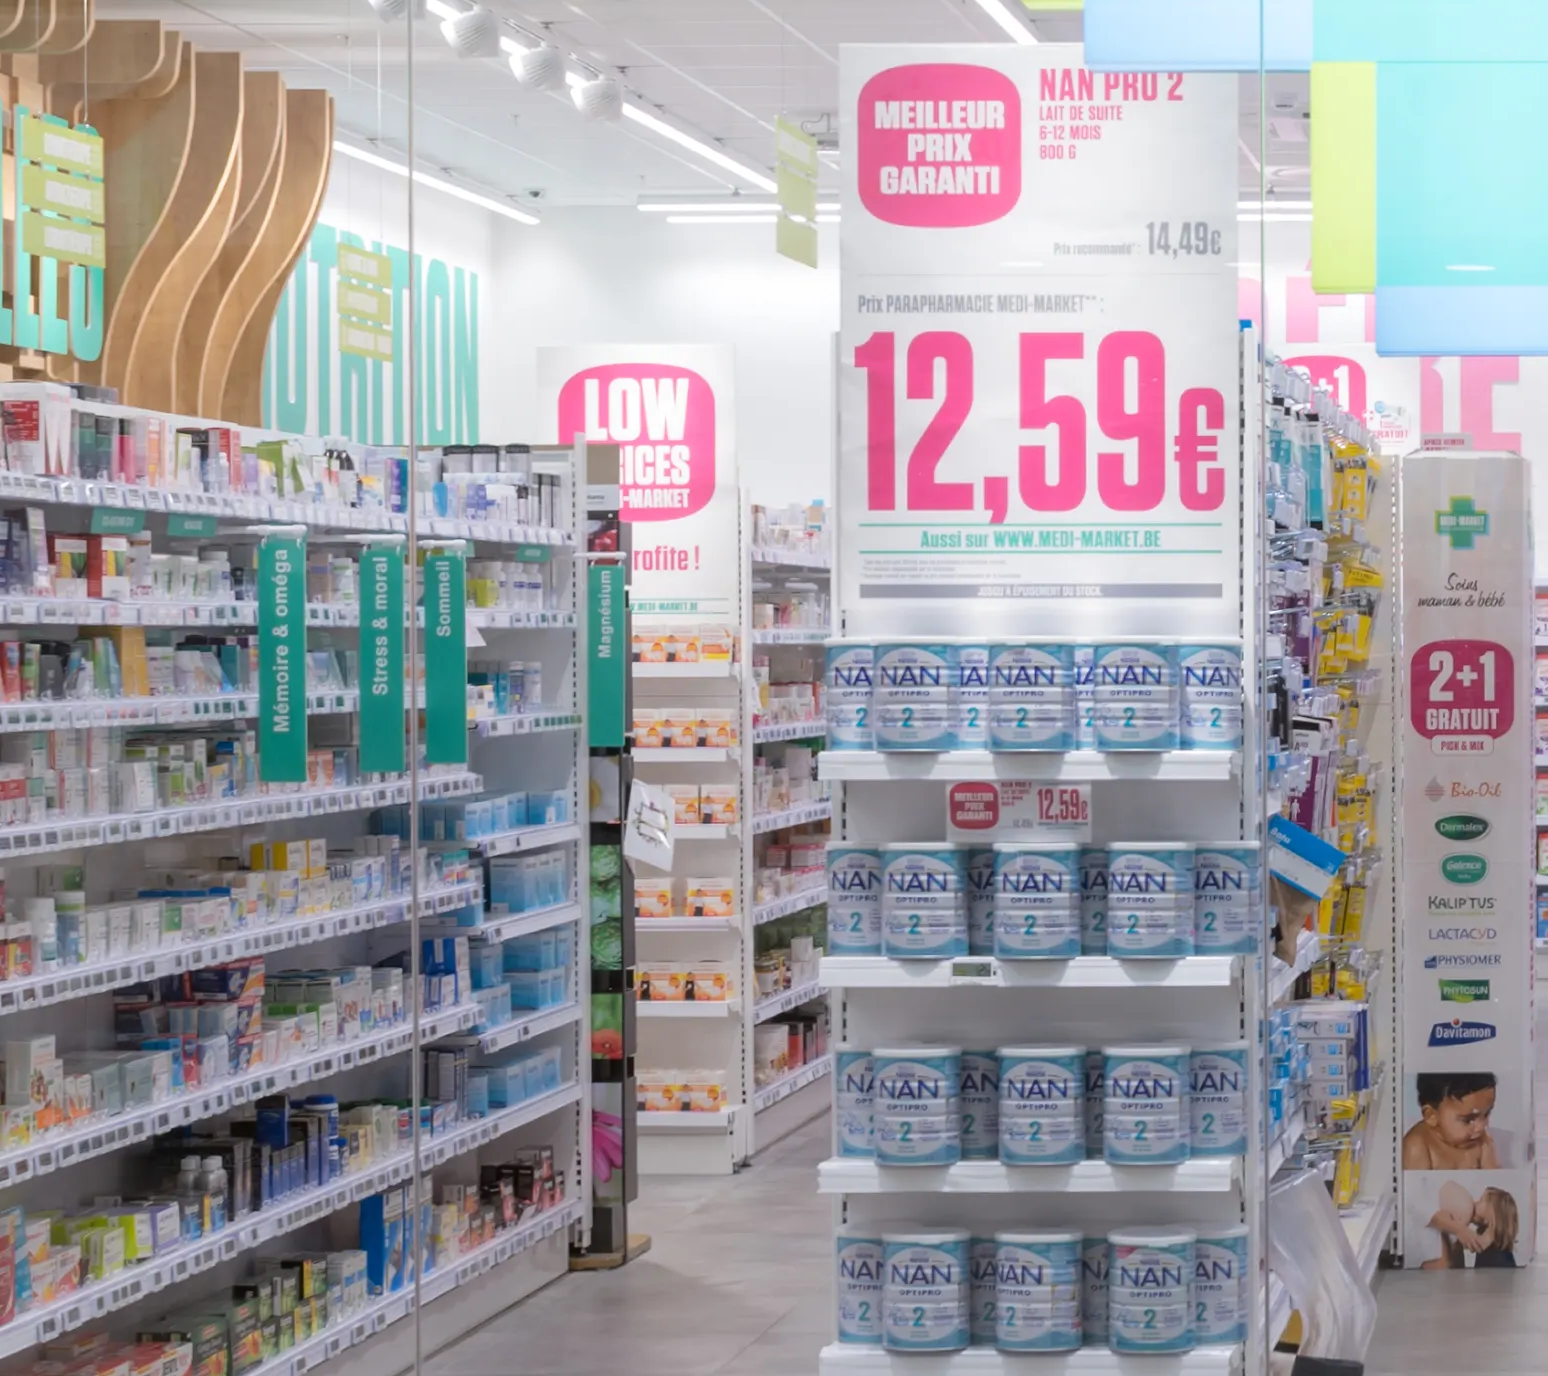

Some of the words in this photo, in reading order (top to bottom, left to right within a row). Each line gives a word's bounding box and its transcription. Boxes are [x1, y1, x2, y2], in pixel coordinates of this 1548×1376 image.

[1040, 68, 1093, 101] NAN
[1104, 71, 1159, 101] PRO
[1167, 71, 1184, 101] 2
[874, 100, 1005, 130] MEILLEUR
[1040, 105, 1066, 121] LAIT
[1070, 105, 1086, 121] DE
[1090, 105, 1123, 121] SUITE
[1040, 125, 1065, 141] 6-12
[1069, 125, 1101, 141] MOIS
[907, 134, 971, 161] PRIX
[1040, 145, 1063, 160] 800
[1068, 145, 1076, 160] G
[880, 166, 1000, 194] GARANTI
[1146, 221, 1221, 260] 14,49€
[858, 295, 884, 314] Prix
[886, 295, 993, 314] PARAPHARMACIE
[585, 378, 689, 440] LOW
[854, 331, 1225, 524] 12,59€
[921, 531, 961, 548] Aussi
[966, 533, 989, 548] sur
[994, 531, 1161, 548] WWW.MEDI-MARKET.BE
[275, 549, 292, 615] oméga
[373, 556, 389, 608] moral
[1445, 573, 1477, 591] Soins
[436, 561, 451, 637] Sommeil
[1418, 597, 1462, 607] maman
[1477, 592, 1504, 607] bébé
[373, 612, 389, 628] &
[598, 570, 613, 659] Magnésium
[273, 625, 290, 642] &
[373, 634, 389, 696] Stress
[881, 666, 940, 685] NAN
[1429, 651, 1495, 701] 2+1
[273, 644, 291, 734] Mémoire
[902, 708, 913, 727] 2
[1426, 708, 1499, 730] GRATUIT
[1451, 783, 1501, 797] Bio-Oil
[1429, 928, 1496, 940] LACTACYD
[1438, 955, 1501, 965] PHYSIOMER
[1443, 986, 1489, 995] PHYTOSUN
[1435, 1026, 1491, 1039] Davitamon
[1120, 1265, 1181, 1286] NAN
[1144, 1309, 1157, 1329] 2
